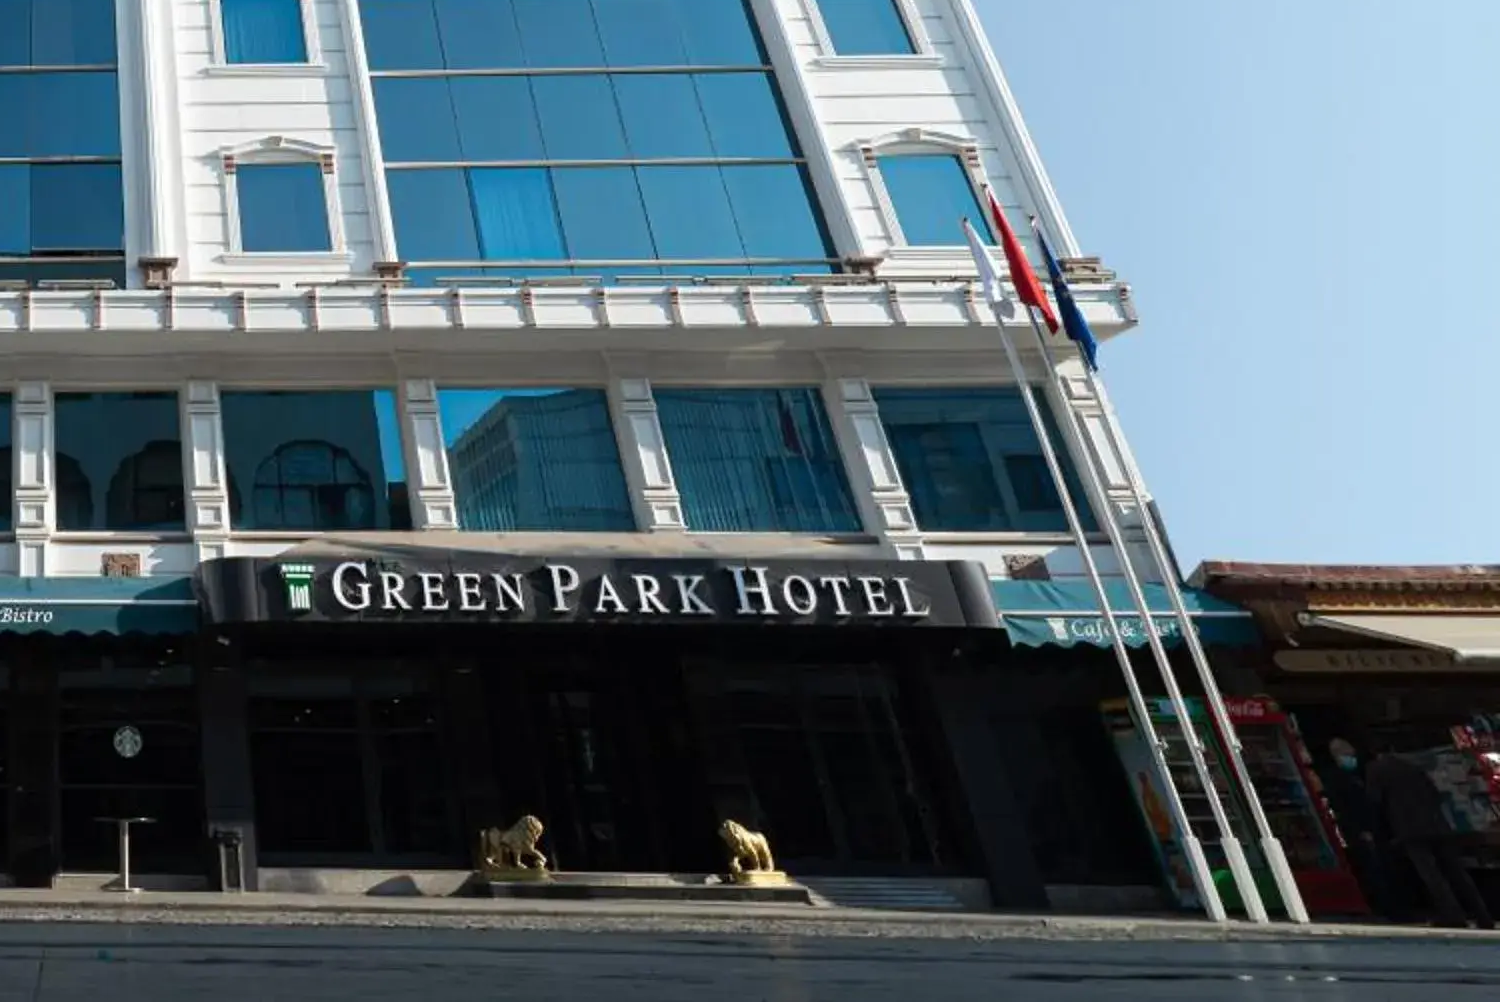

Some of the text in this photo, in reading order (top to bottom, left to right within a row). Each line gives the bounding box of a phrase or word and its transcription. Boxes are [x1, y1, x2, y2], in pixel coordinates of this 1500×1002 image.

[331, 561, 932, 618] GREEN PARK HOTEL
[0, 607, 53, 623] Bistro
[1120, 620, 1136, 637] &
